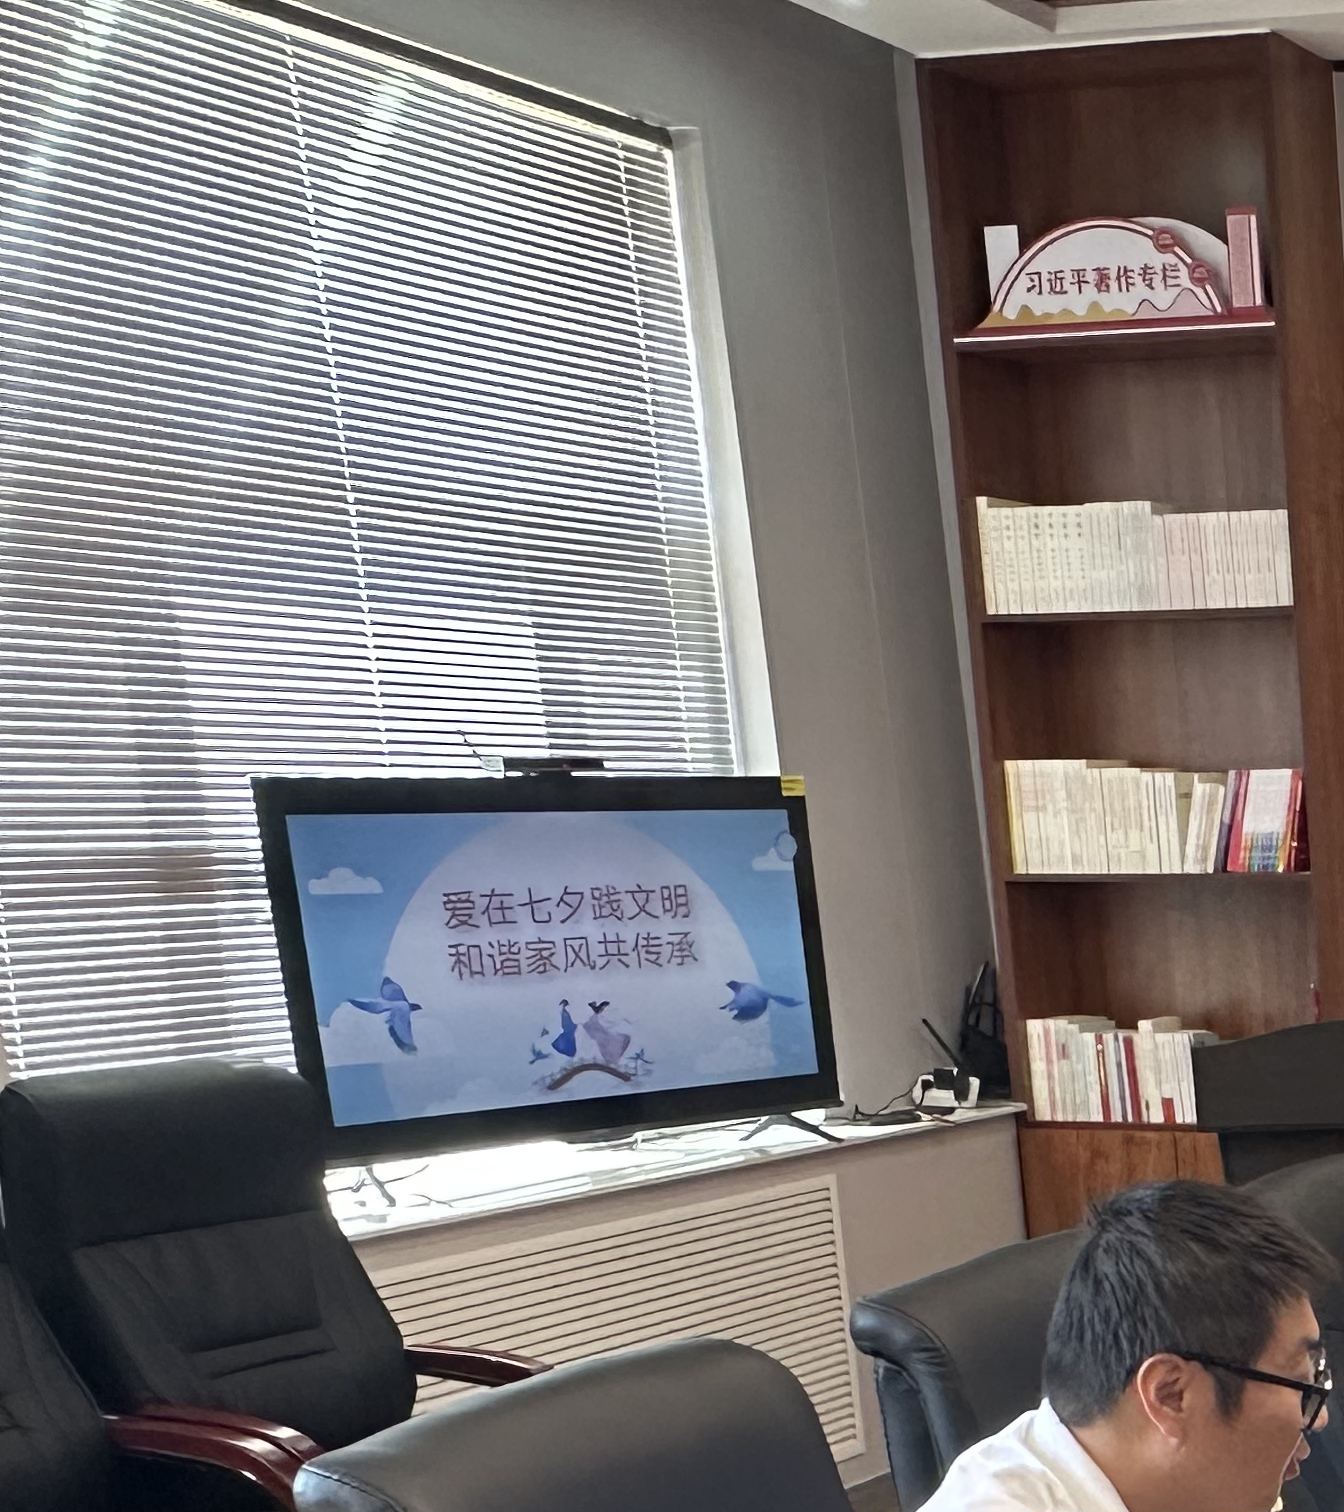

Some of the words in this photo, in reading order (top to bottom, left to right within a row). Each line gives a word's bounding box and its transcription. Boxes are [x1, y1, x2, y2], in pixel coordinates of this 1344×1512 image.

[1025, 262, 1183, 296] 习近平著作专栏
[442, 883, 692, 929] 爱在七夕践文明
[448, 931, 699, 981] 和谐家风共传承
